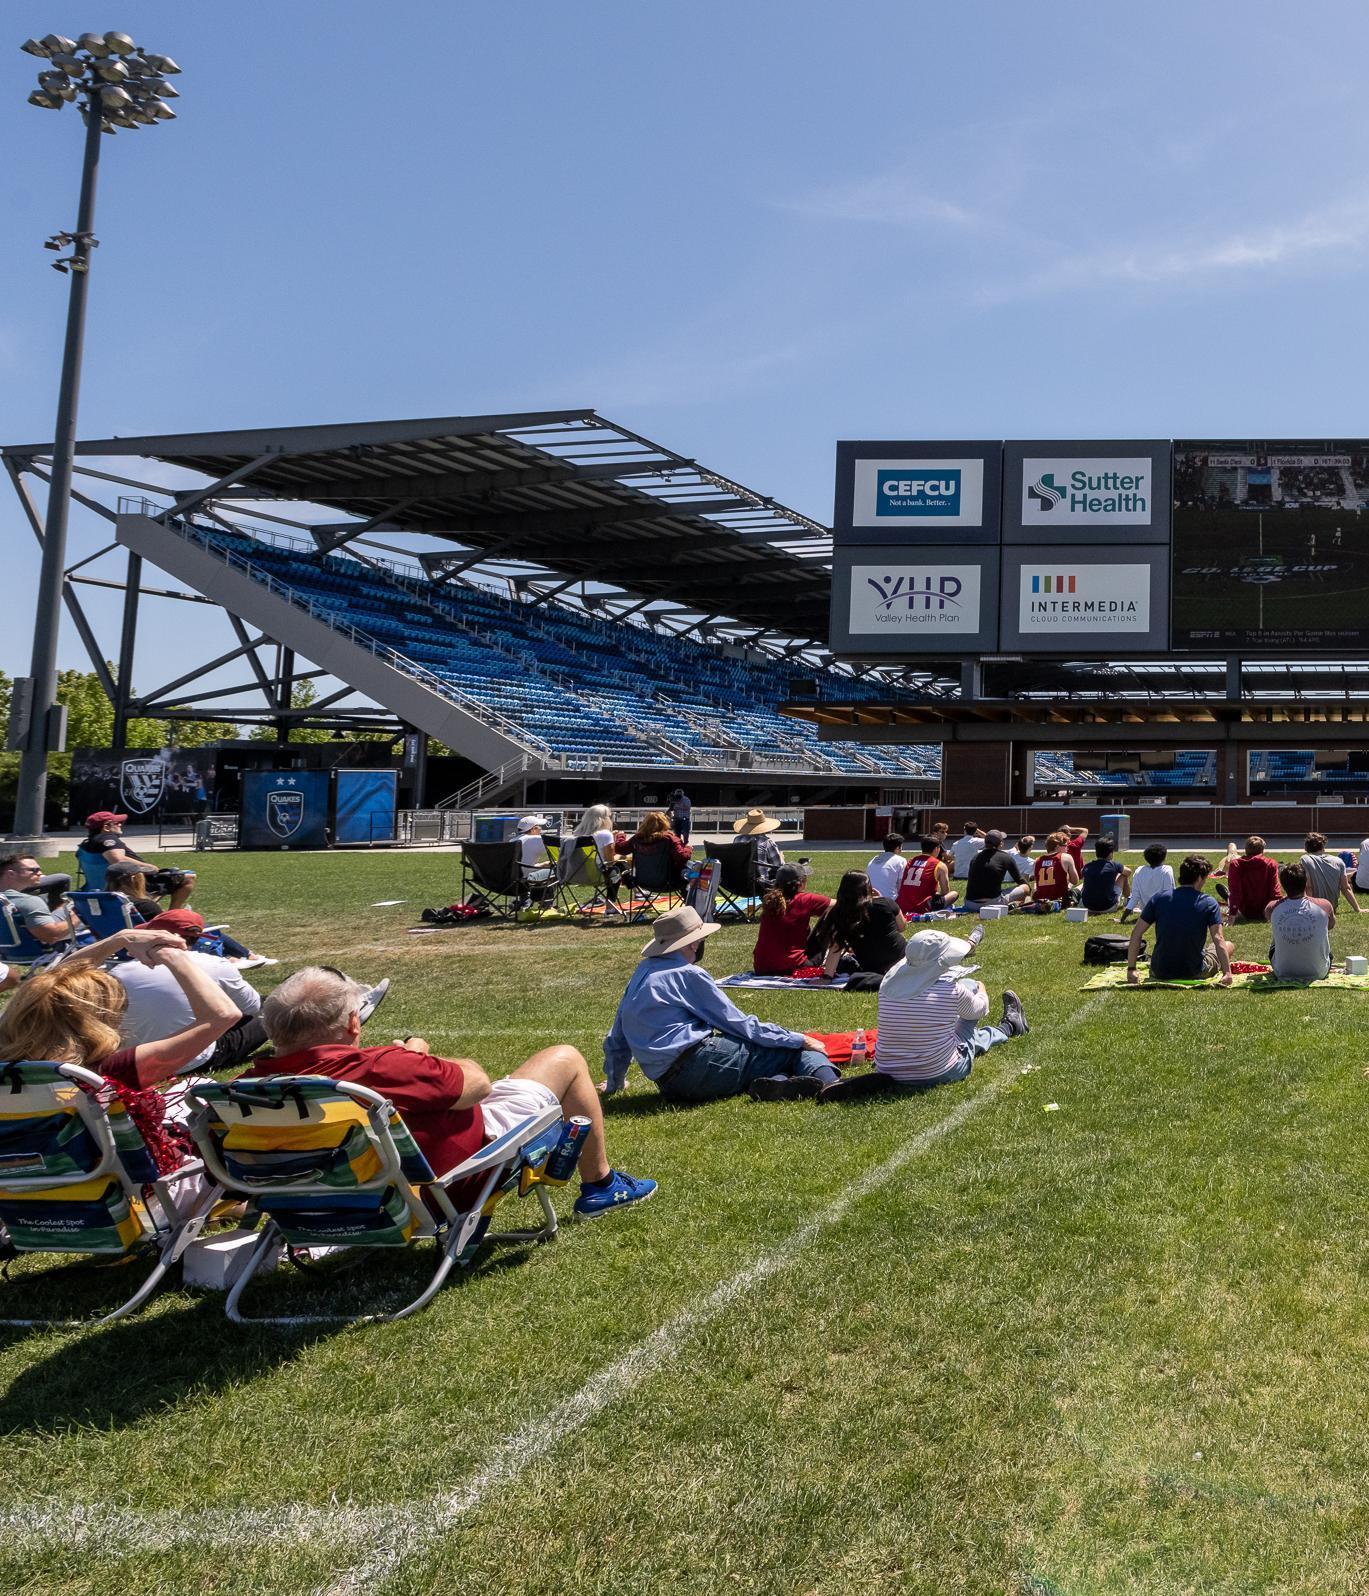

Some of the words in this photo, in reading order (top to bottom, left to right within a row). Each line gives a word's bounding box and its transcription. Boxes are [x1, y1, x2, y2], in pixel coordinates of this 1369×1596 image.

[882, 480, 956, 496] CEFCU
[1070, 470, 1145, 491] Sutter
[1070, 493, 1146, 513] Health
[867, 576, 962, 610] VHP
[1031, 600, 1137, 612] INTERMEDIA
[875, 613, 903, 624] Valley
[905, 613, 937, 623] Health
[939, 613, 960, 623] Plan
[125, 763, 162, 773] QUAKES
[270, 795, 301, 803] QUAKES
[903, 867, 924, 886] 11
[1038, 866, 1056, 886] 11
[66, 1219, 85, 1227] Spot
